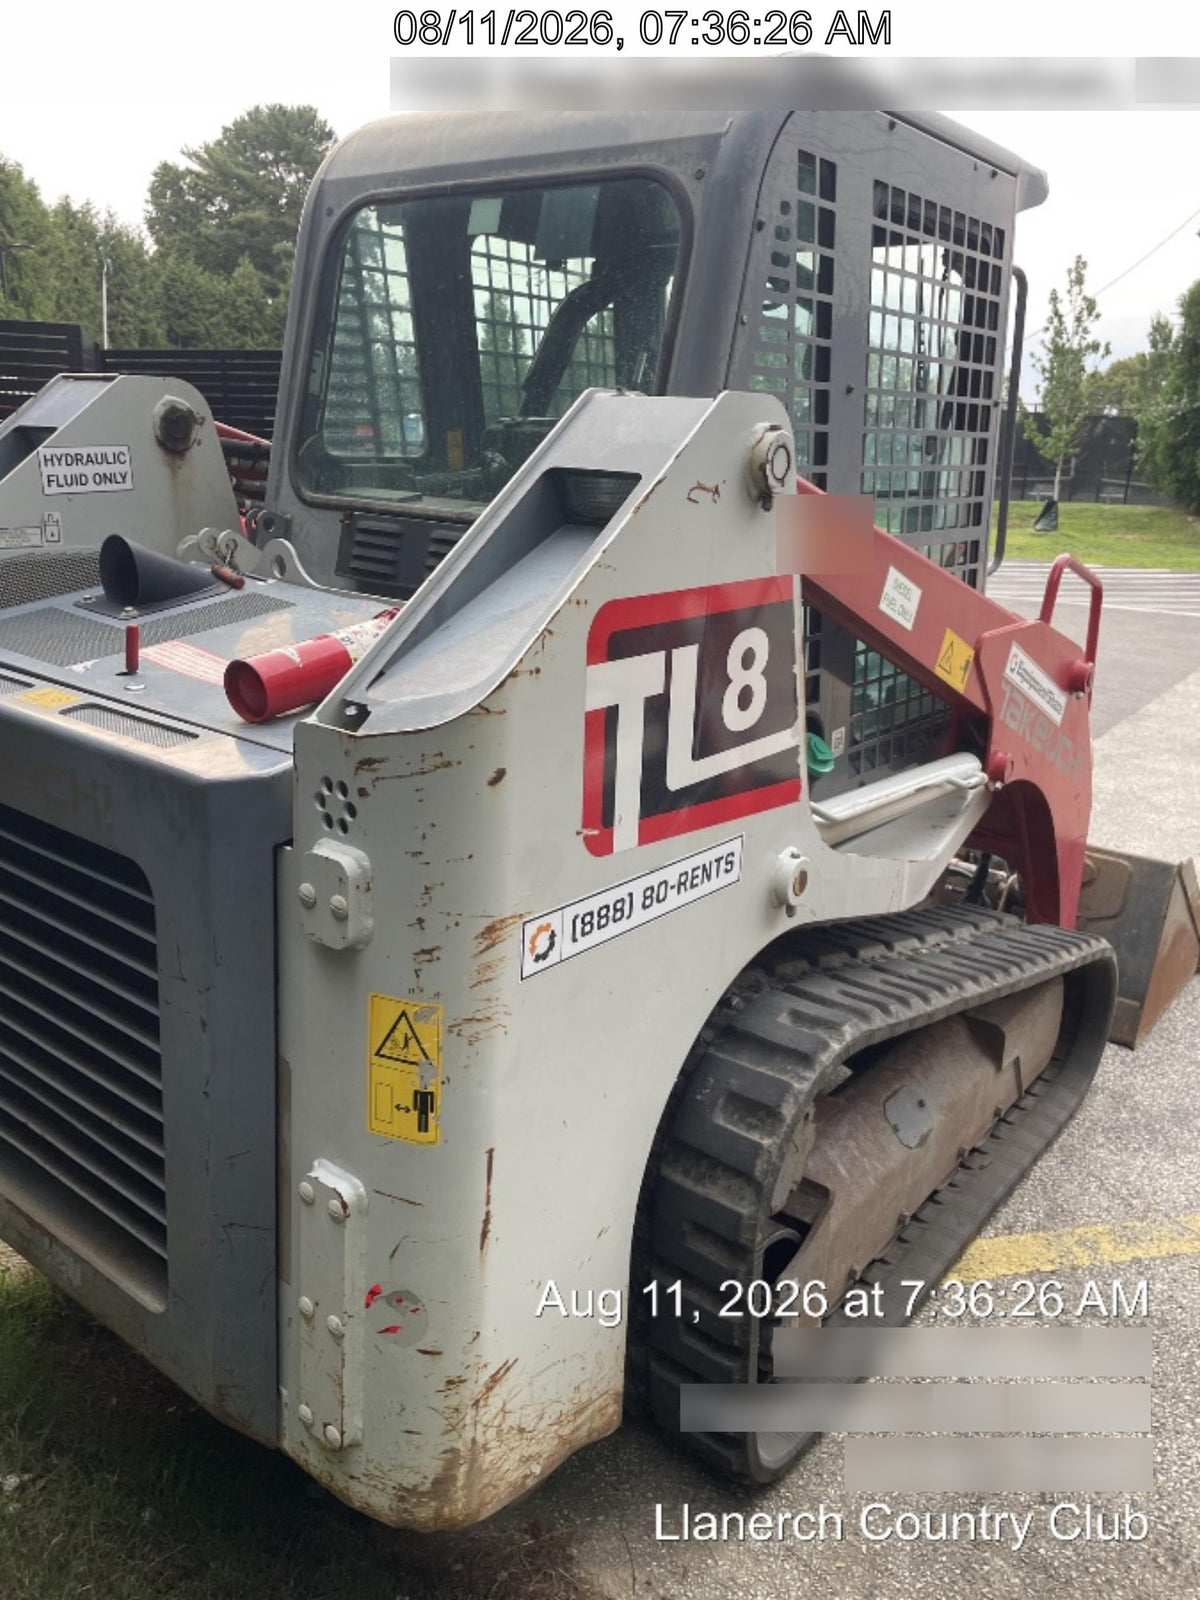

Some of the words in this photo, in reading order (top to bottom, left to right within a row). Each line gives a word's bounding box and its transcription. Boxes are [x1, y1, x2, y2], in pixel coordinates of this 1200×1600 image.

[43, 451, 128, 467] HYDRAULIC
[46, 473, 89, 488] FLUID
[92, 471, 128, 486] ONLY
[571, 892, 634, 943] (888)
[641, 851, 735, 911] 80-RENTS
